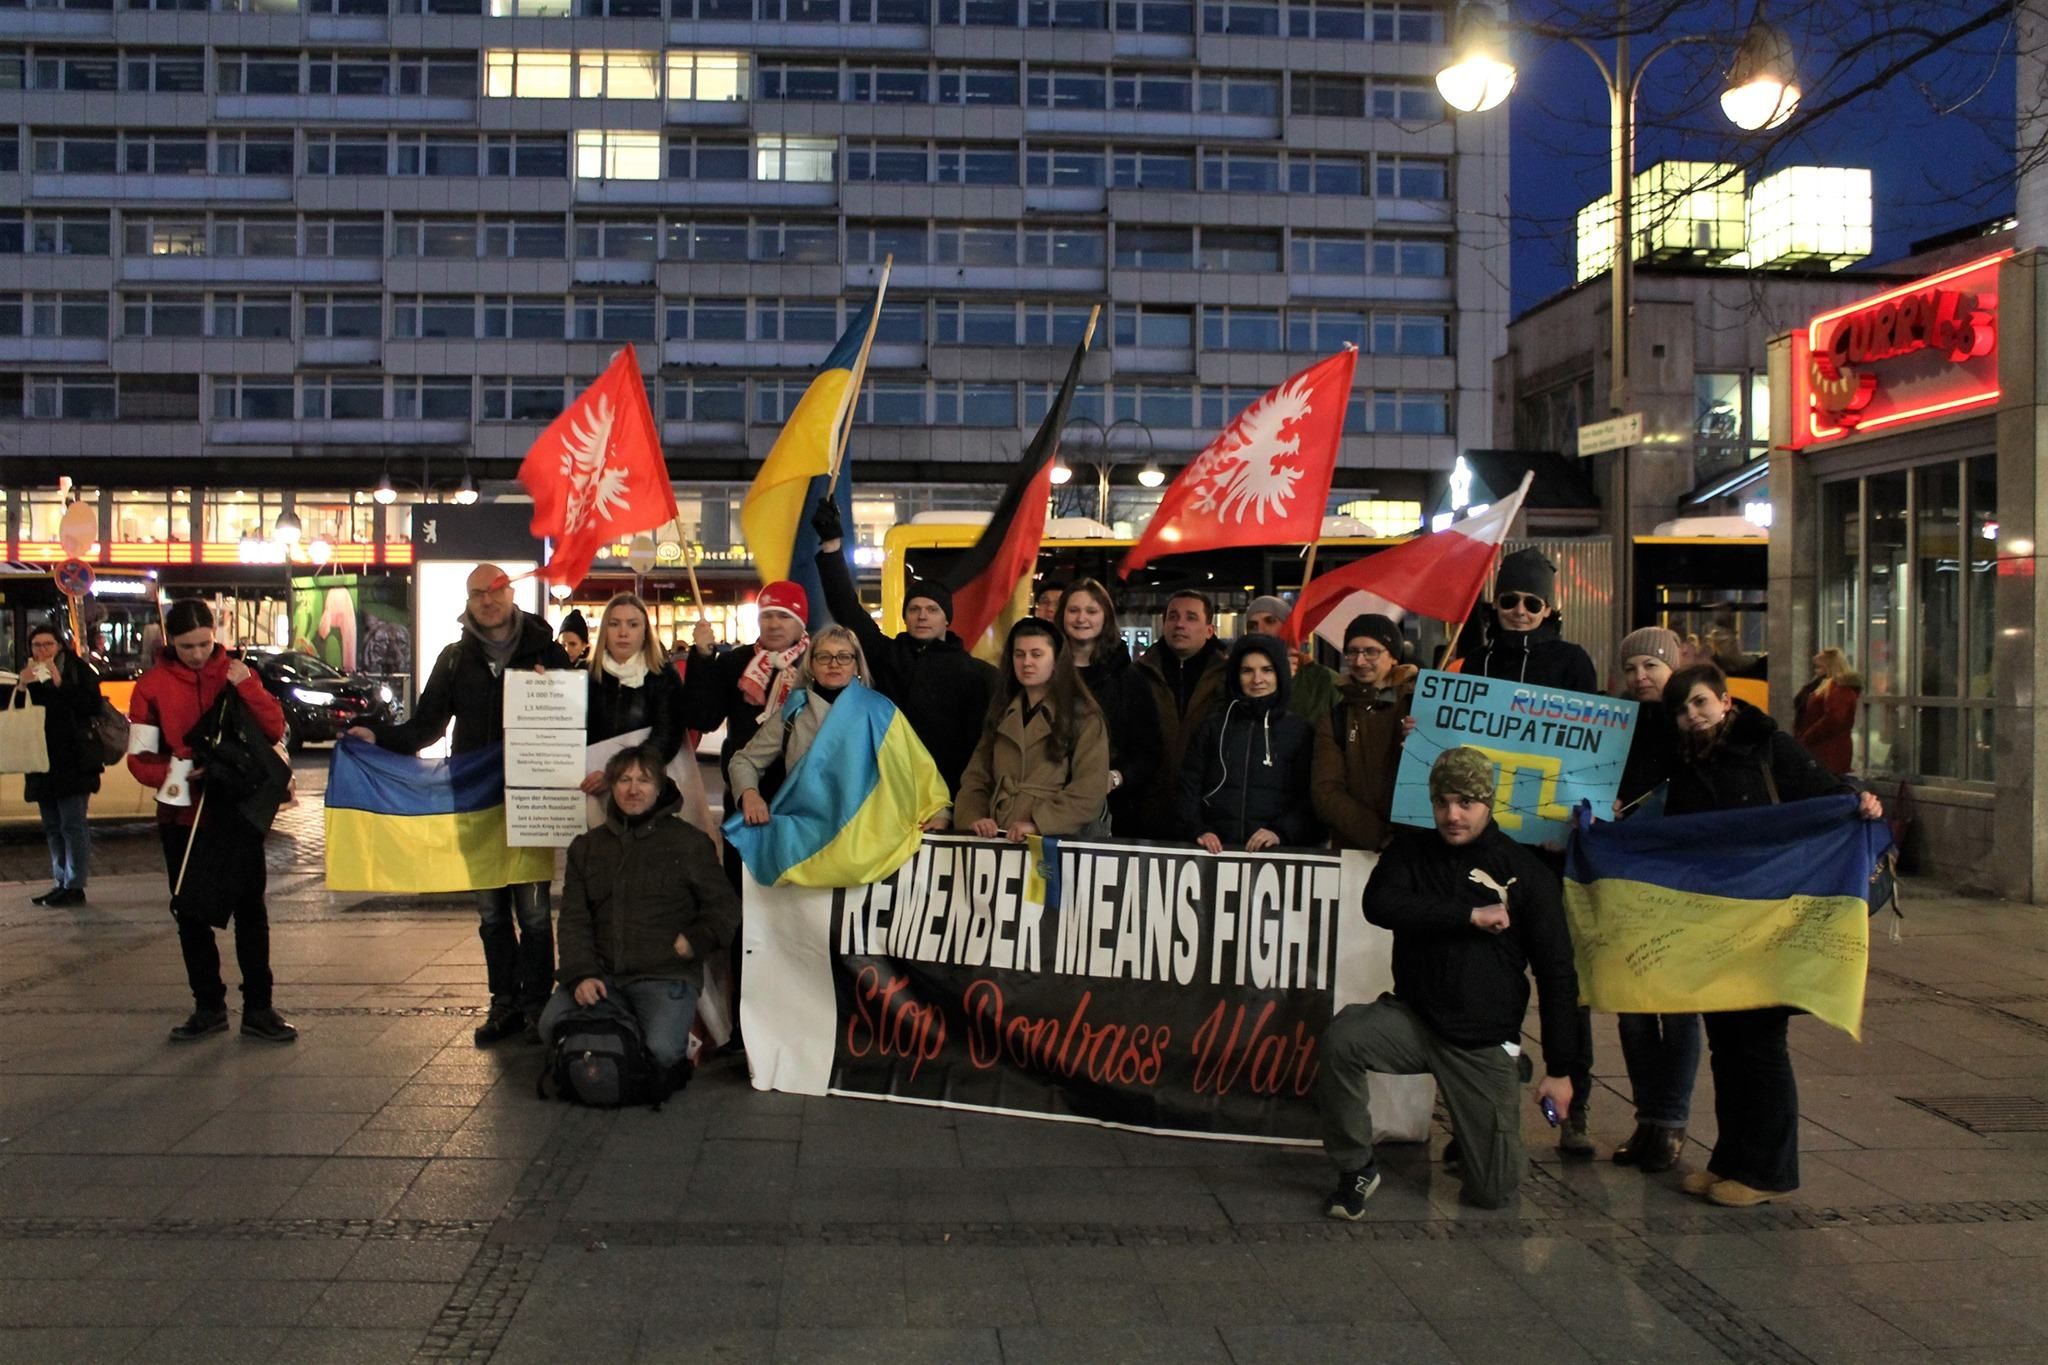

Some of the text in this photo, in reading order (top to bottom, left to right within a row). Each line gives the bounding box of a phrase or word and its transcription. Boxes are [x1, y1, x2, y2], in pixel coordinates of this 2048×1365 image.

[1421, 675, 1631, 731] STOP RUSSIAN
[1435, 705, 1603, 754] OCCUPATION
[840, 844, 1341, 991] REMENBER MEANS FIGHT
[848, 965, 1321, 1097] Stop Donbass War
